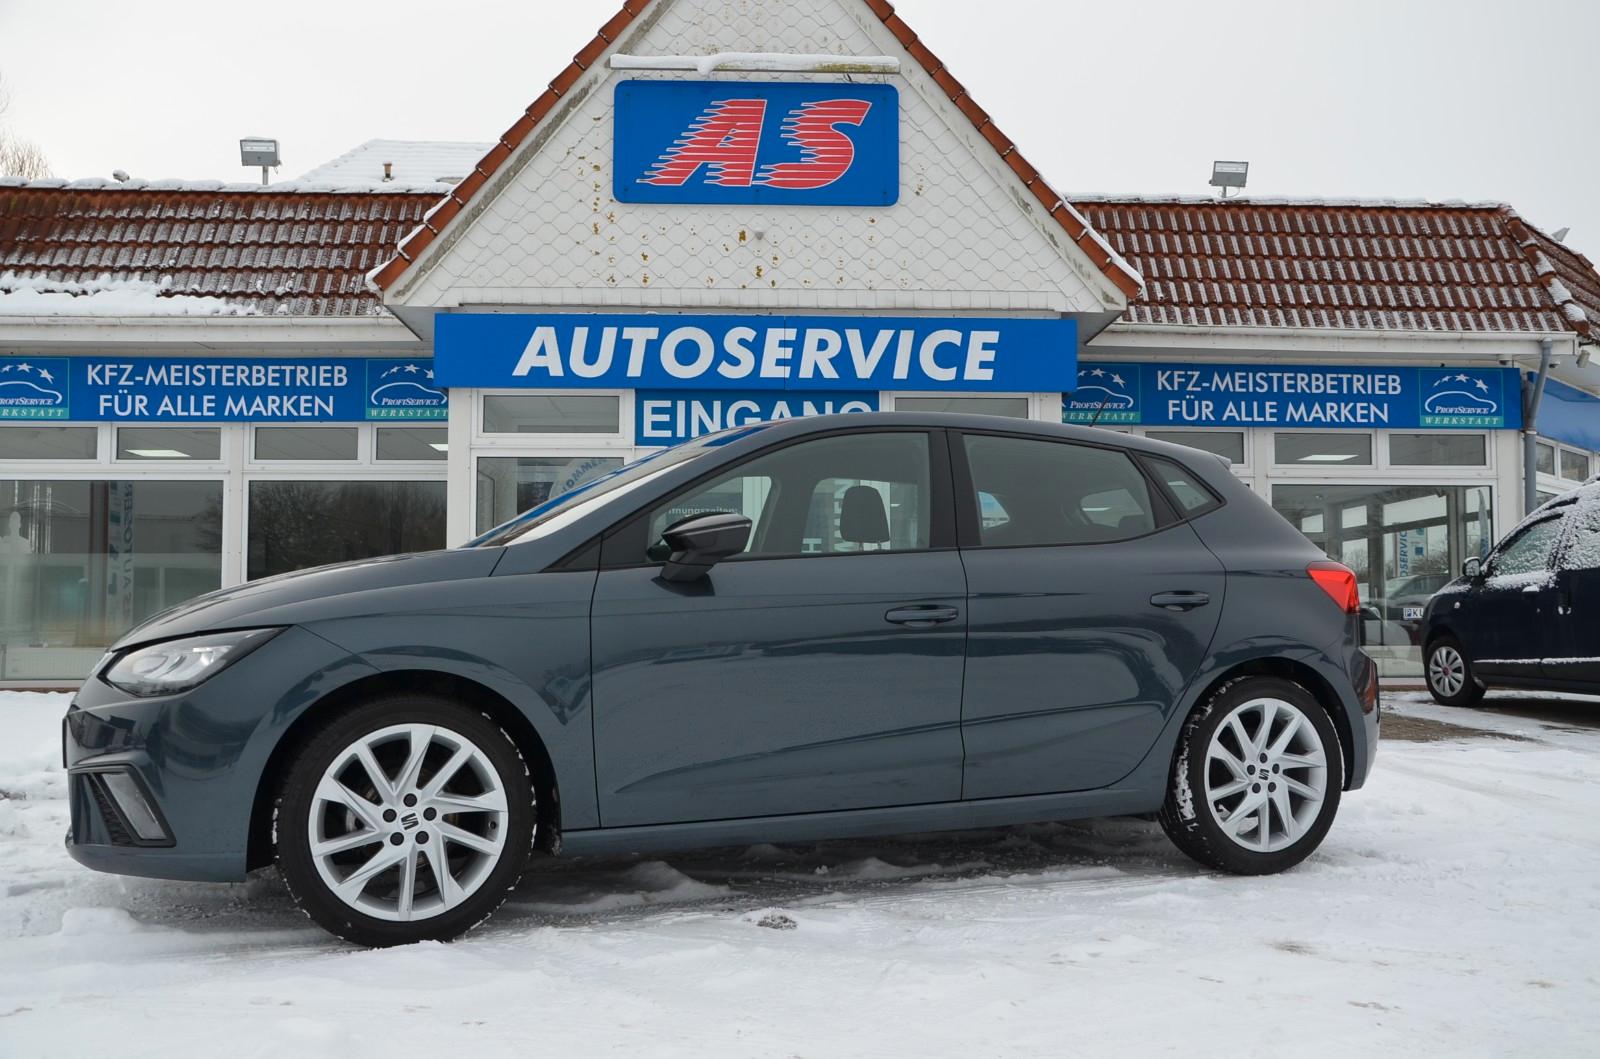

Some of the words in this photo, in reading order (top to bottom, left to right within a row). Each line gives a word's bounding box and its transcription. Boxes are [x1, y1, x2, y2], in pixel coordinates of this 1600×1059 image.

[635, 98, 872, 190] AS
[512, 326, 1000, 381] AUTOSERVICE
[87, 364, 348, 387] KFZ-MEISTERBETRIEB
[1157, 370, 1402, 395] KFZ-MEISTERBETRIEB
[99, 389, 149, 417] FÜR
[156, 395, 216, 417] ALLE
[223, 395, 335, 417] MARKEN
[371, 408, 448, 417] WERKSTATT
[1168, 395, 1216, 421] FÜR
[1222, 400, 1279, 422] ALLE
[1285, 402, 1389, 424] MARKEN
[1062, 412, 1136, 421] ERKTATT
[1425, 416, 1499, 425] WERKSTATT
